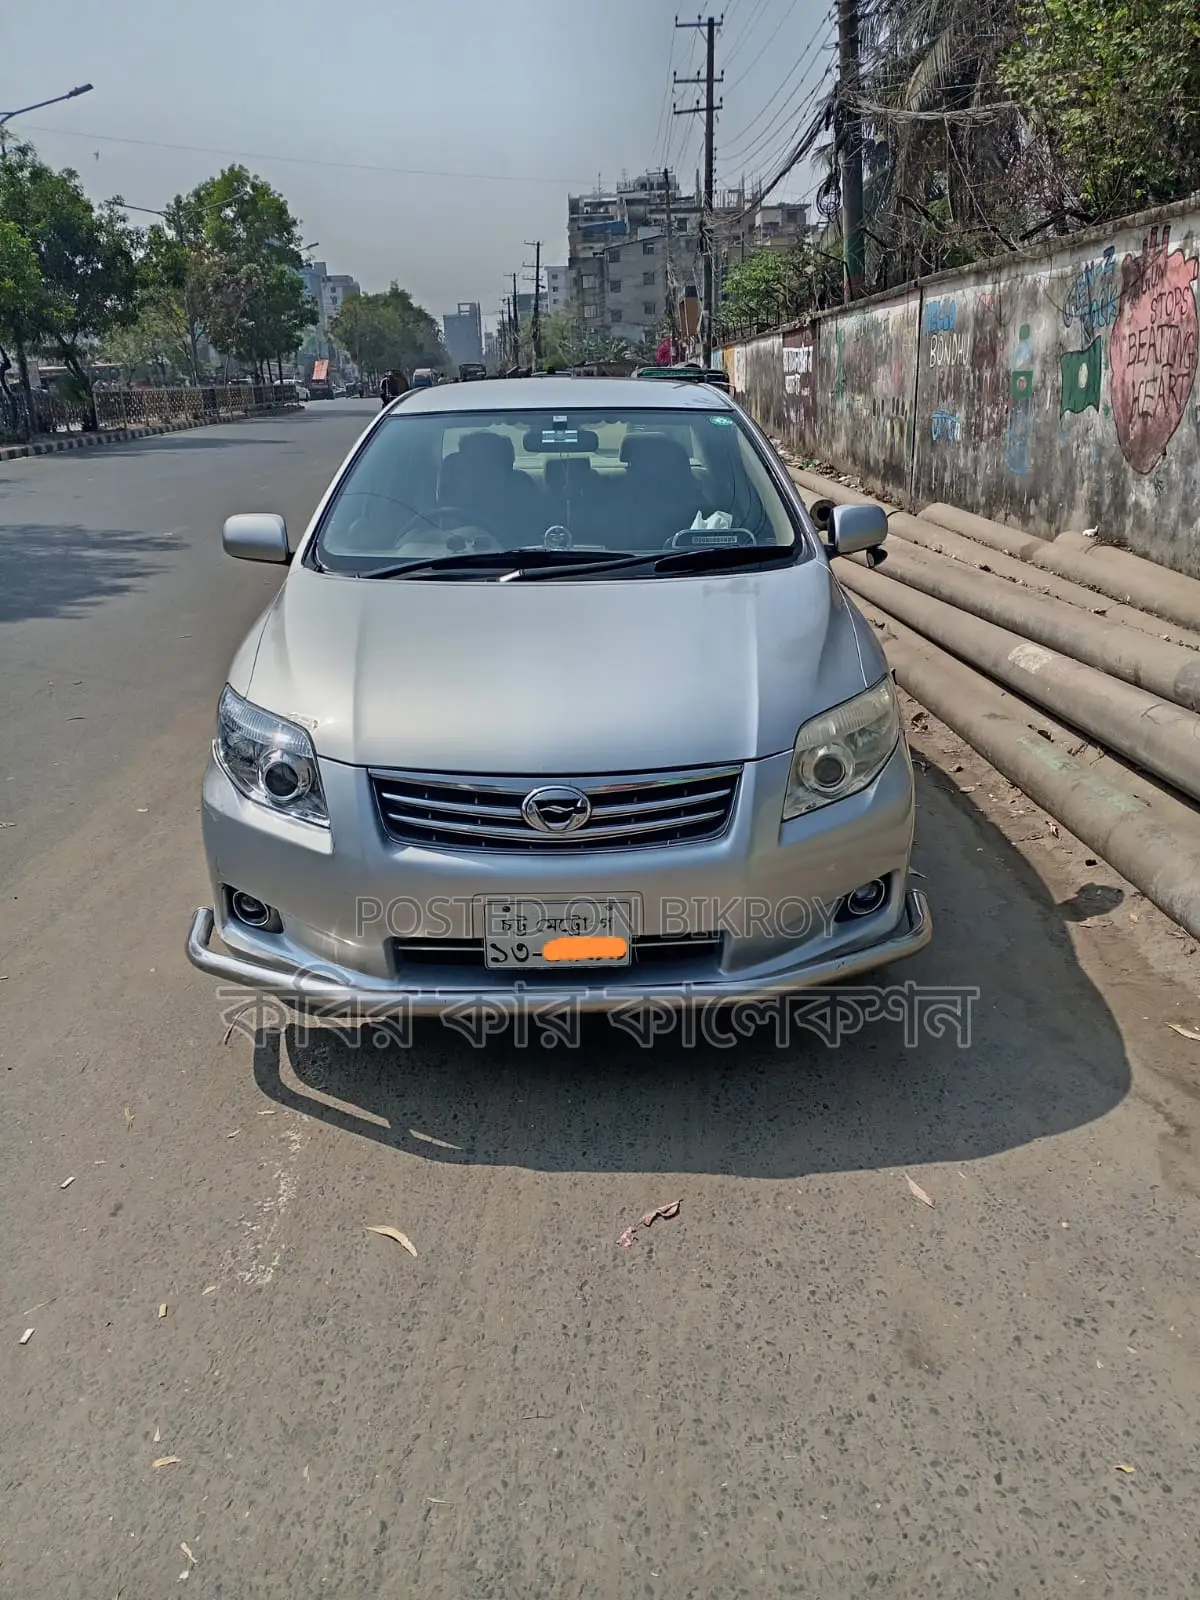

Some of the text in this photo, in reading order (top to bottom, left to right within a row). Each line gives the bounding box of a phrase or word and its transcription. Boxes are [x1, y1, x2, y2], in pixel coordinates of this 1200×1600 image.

[1150, 286, 1189, 324] STOPS
[929, 333, 971, 368] BONDHU
[1128, 371, 1190, 423] HEART
